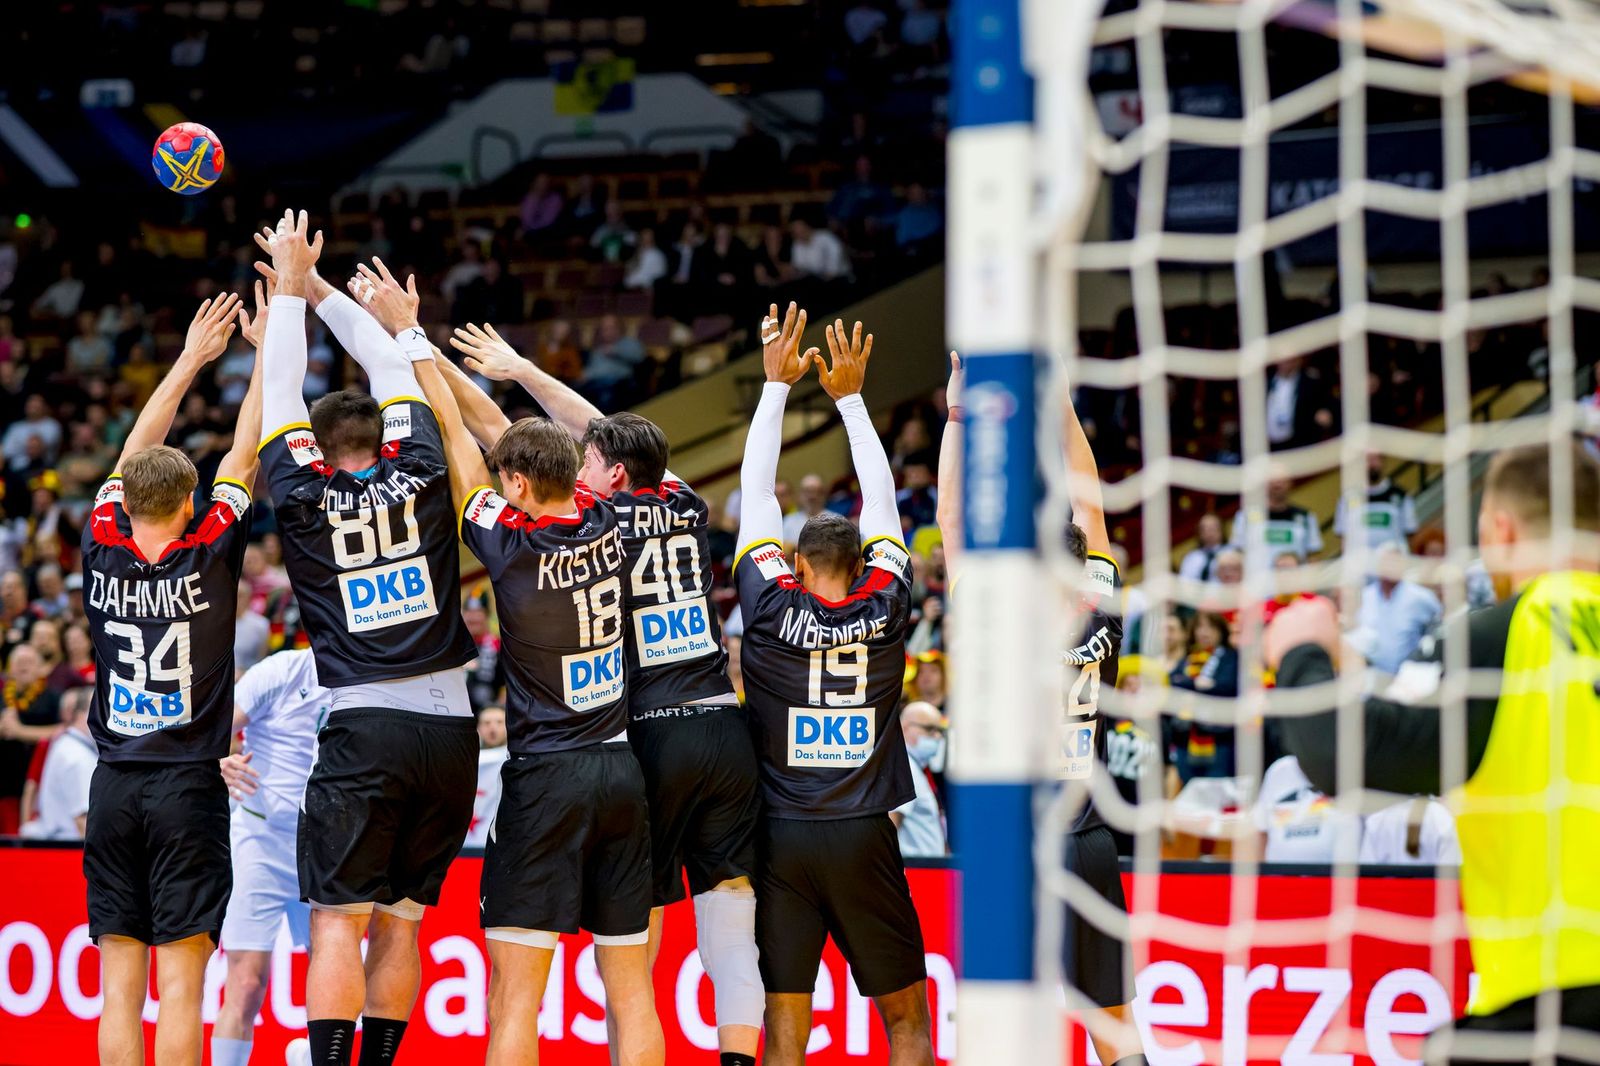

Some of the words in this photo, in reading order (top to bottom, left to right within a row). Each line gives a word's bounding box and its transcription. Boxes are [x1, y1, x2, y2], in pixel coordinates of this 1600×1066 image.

[327, 493, 421, 569] 80
[537, 526, 627, 590] KÖSTER
[631, 534, 703, 604] 40
[89, 570, 210, 618] DAHMKE
[347, 566, 425, 610] DKB
[354, 614, 374, 625] Das
[377, 609, 401, 620] kann
[403, 600, 429, 614] Bank
[572, 575, 621, 648] 18
[641, 605, 706, 644] DKB
[778, 606, 888, 649] M'BENGUE
[104, 620, 194, 691] 34
[569, 646, 622, 691] DKB
[646, 648, 665, 659] Das
[667, 645, 688, 656] kann
[690, 638, 710, 651] Bank
[808, 642, 869, 707] 19
[112, 683, 184, 717] DKB
[572, 694, 589, 706] Das
[591, 690, 611, 700] kann
[633, 706, 680, 721] CRAFT
[112, 714, 127, 728] Das
[130, 718, 154, 731] kann
[795, 715, 869, 745] DKB
[795, 750, 815, 760] Das
[817, 750, 841, 760] kann
[845, 750, 867, 760] Bank
[1086, 960, 1480, 1066] erze
